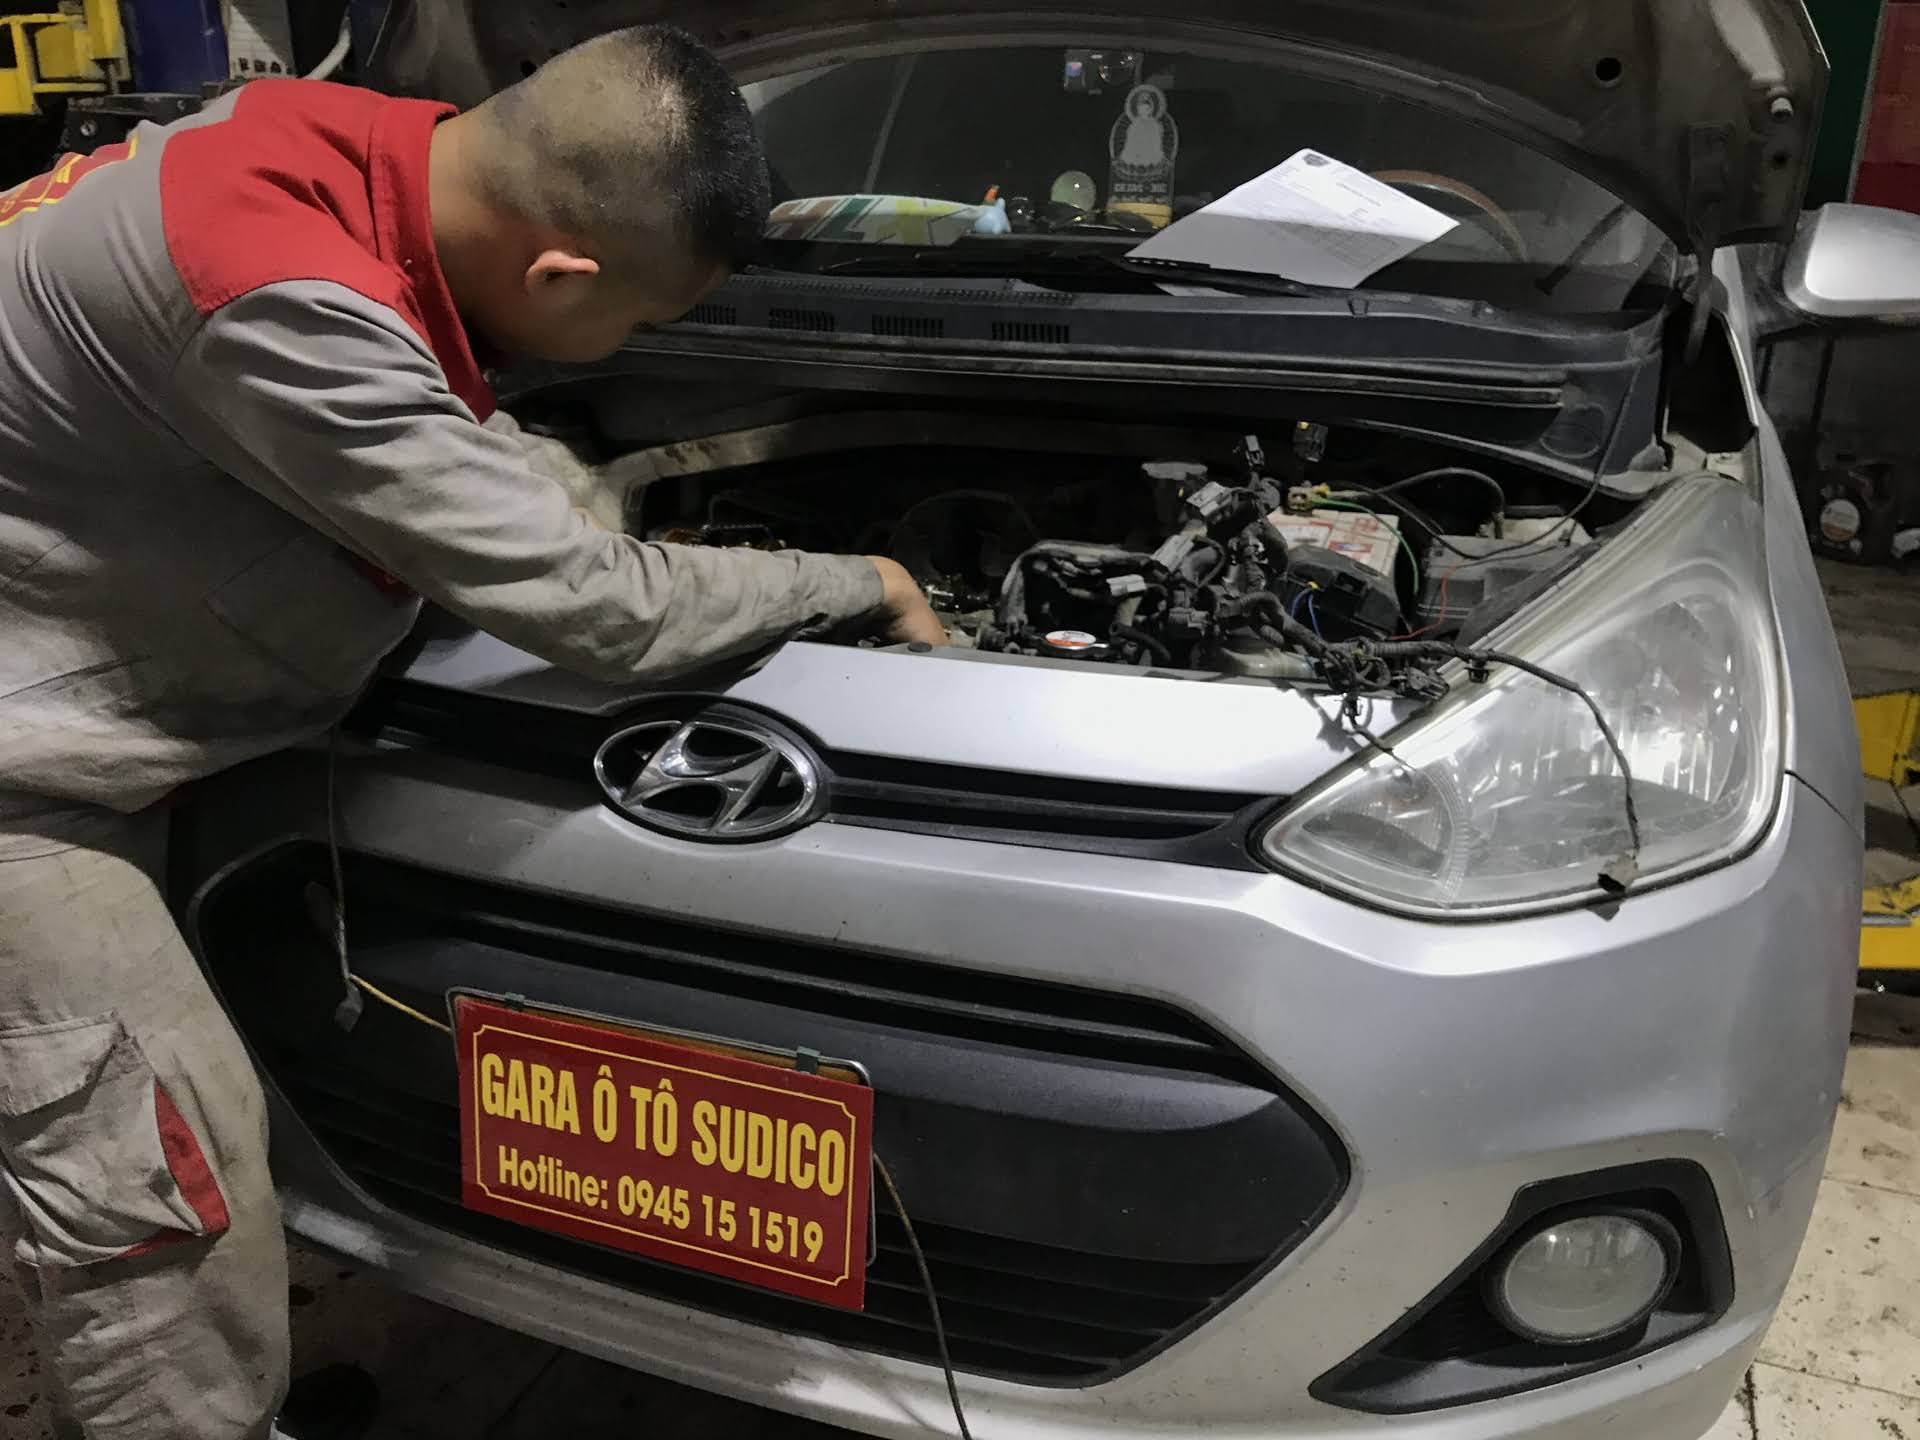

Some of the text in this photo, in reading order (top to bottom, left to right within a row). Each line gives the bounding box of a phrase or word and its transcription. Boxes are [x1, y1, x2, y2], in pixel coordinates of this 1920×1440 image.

[481, 1053, 846, 1197] GARA Ô TÔ SUDICO
[498, 1145, 824, 1262] Hotline: 0945 15 1519
